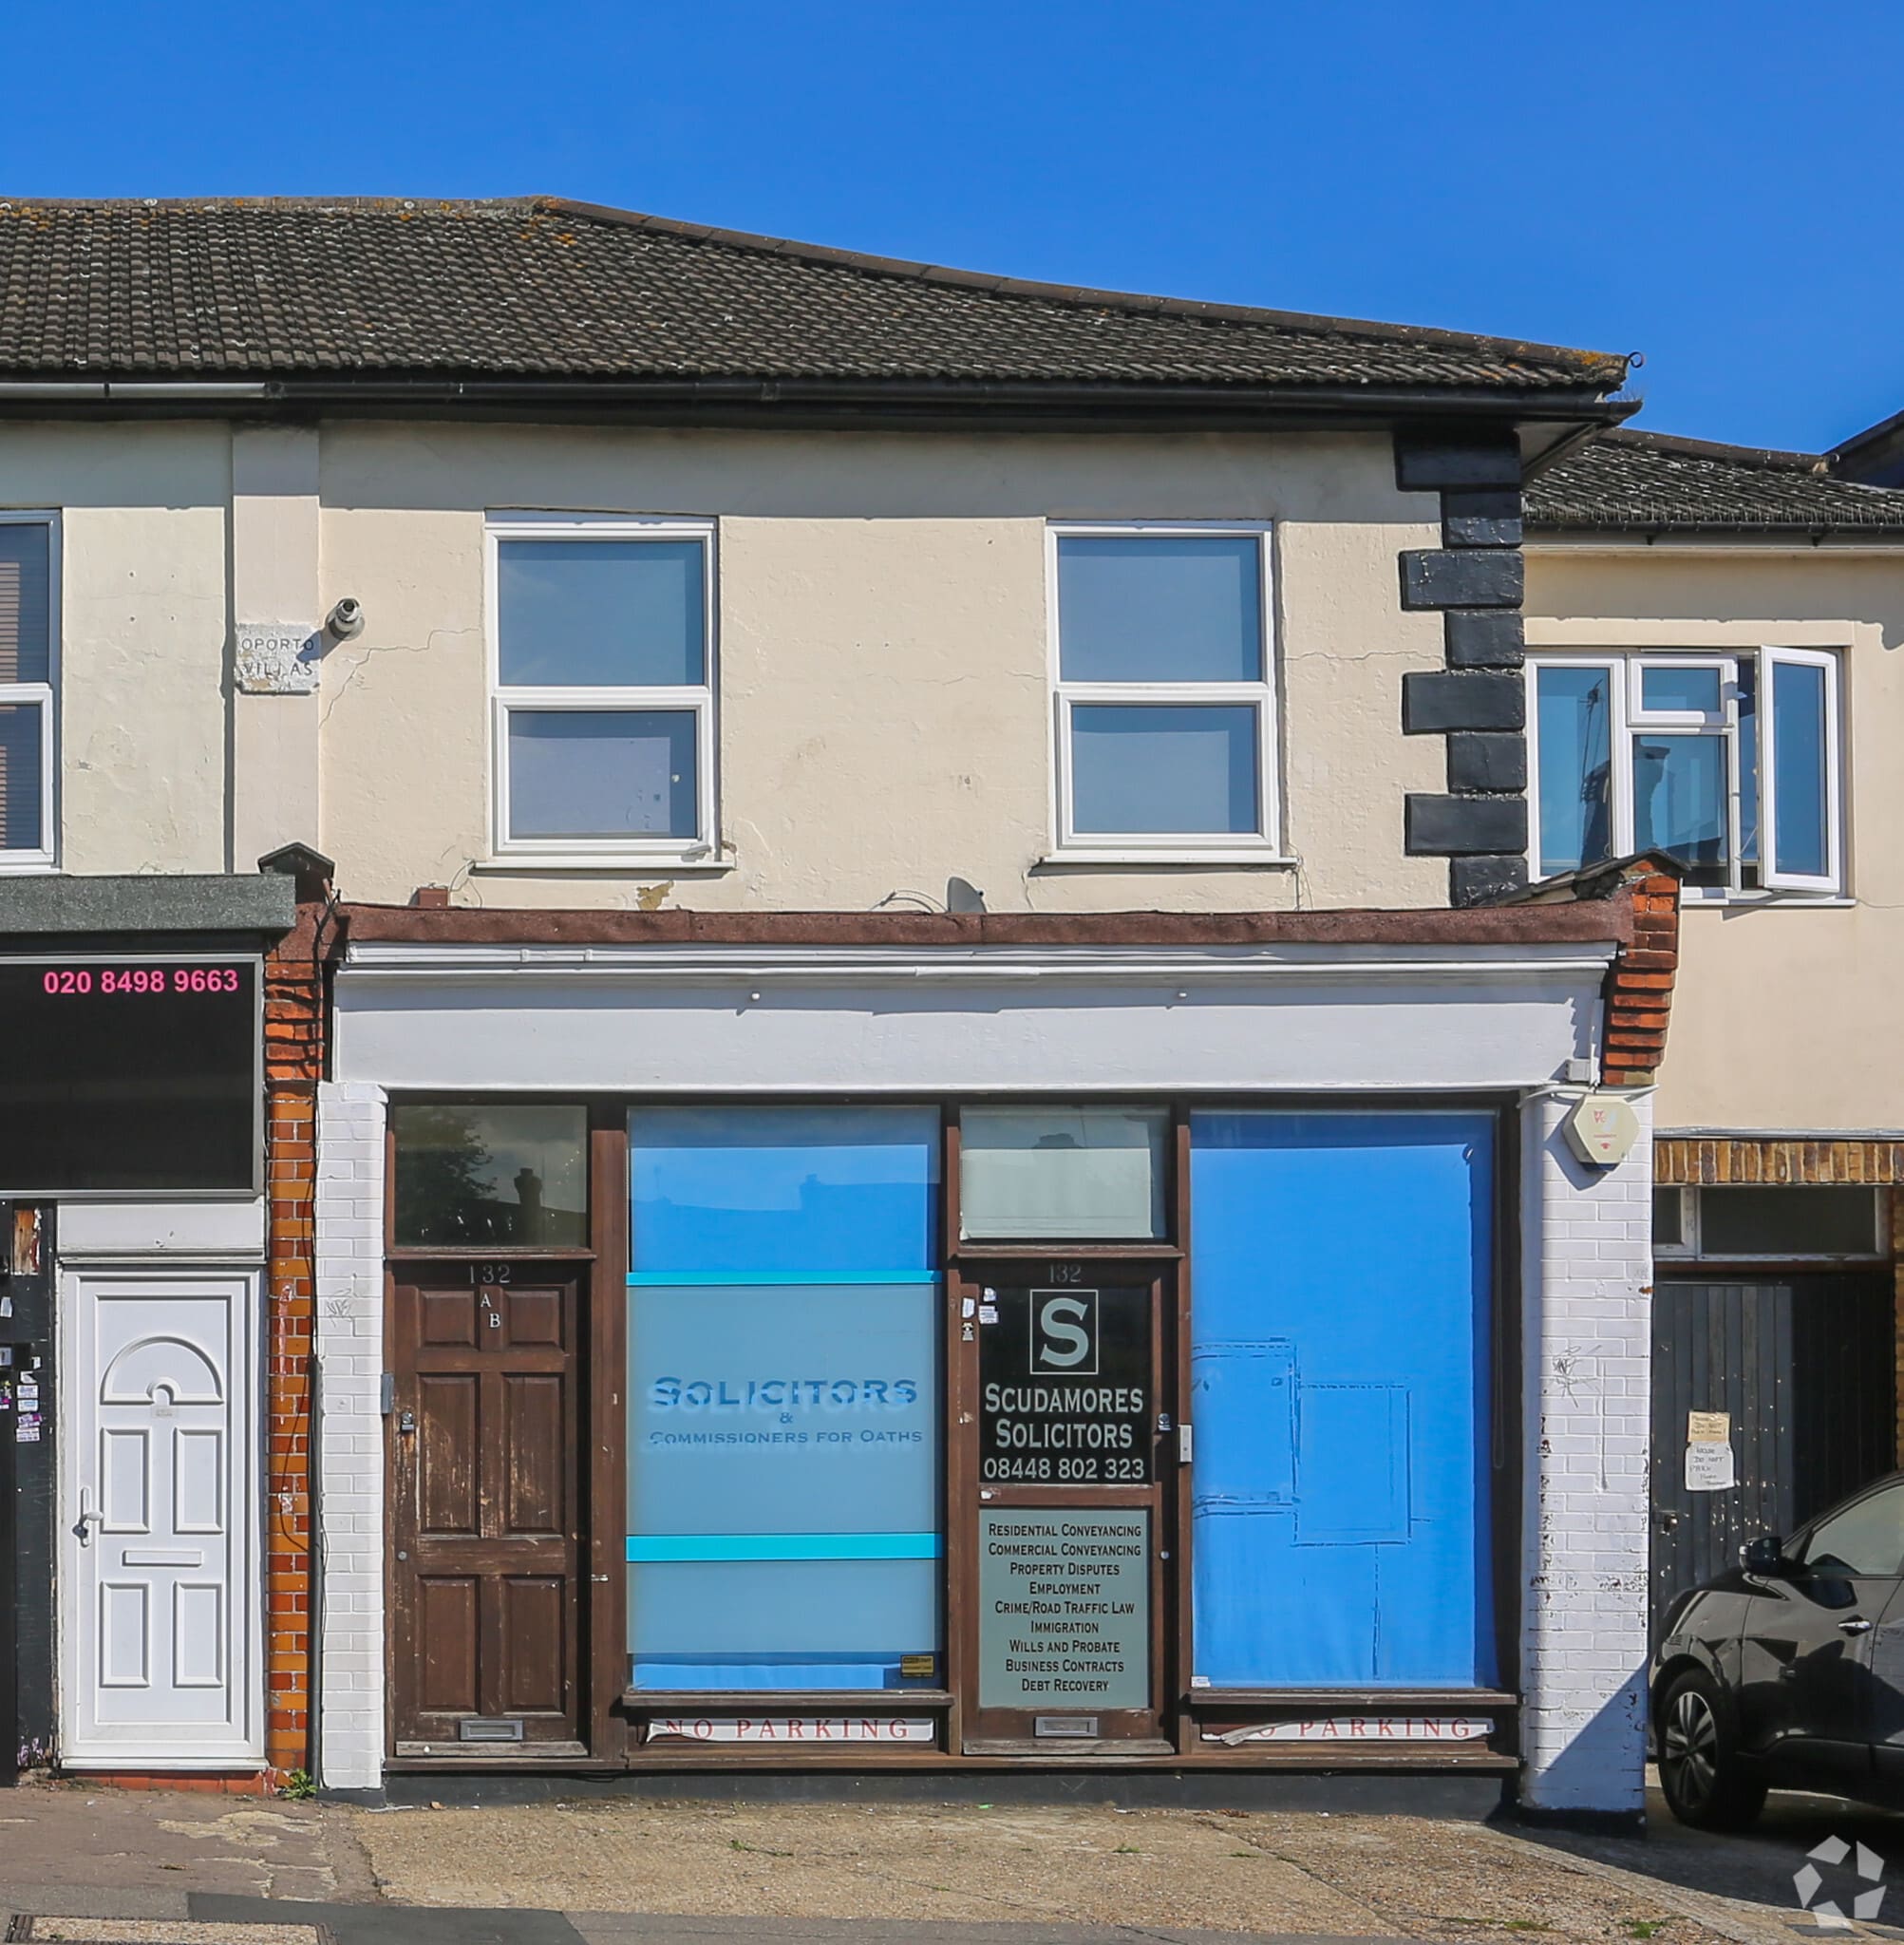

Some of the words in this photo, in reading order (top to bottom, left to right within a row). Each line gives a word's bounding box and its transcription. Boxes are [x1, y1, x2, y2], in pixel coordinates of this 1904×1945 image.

[241, 638, 314, 651] OPORTO
[44, 971, 92, 993] 020
[101, 970, 165, 992] 8498
[174, 970, 238, 991] 9663
[469, 1264, 511, 1284] 132
[1048, 1264, 1082, 1283] 132
[480, 1293, 492, 1308] A
[489, 1312, 501, 1328] B
[1040, 1297, 1089, 1367] S
[653, 1376, 918, 1406] SOLICITORS
[985, 1383, 1144, 1413] SCUDAMORES
[779, 1411, 794, 1425] &
[650, 1431, 808, 1445] COMMISSIONERS
[816, 1431, 853, 1444] FOR
[859, 1429, 923, 1443] OATHS
[995, 1418, 1133, 1449] SOLICITORS
[984, 1458, 1051, 1479] 08448
[1058, 1458, 1099, 1480] 802
[1104, 1458, 1145, 1480] 323
[989, 1523, 1058, 1538] RESIDENTIAL
[1061, 1523, 1141, 1538] CONVEYANCING
[989, 1542, 1058, 1557] COMMERCIAL
[1061, 1542, 1141, 1557] CONVEYANCING
[1010, 1562, 1064, 1576] PROPERTY
[1067, 1562, 1120, 1576] DISPUTES
[1029, 1581, 1101, 1595] EMPLOYMENT
[995, 1601, 1062, 1615] CRIME/ROAD
[1064, 1601, 1108, 1615] TRAFFIC
[1111, 1601, 1135, 1615] LAW
[1030, 1621, 1099, 1633] IMMIGRATION
[1009, 1639, 1044, 1652] WILLS
[1046, 1639, 1068, 1652] AND
[1072, 1639, 1121, 1652] PROBATE
[1006, 1659, 1059, 1672] BUSINESS
[1063, 1659, 1124, 1672] CONTRACTS
[1022, 1678, 1050, 1691] DEBT
[1053, 1678, 1109, 1691] RECOVERY
[736, 1718, 908, 1739] PARKING
[1299, 1718, 1470, 1738] PARKING
